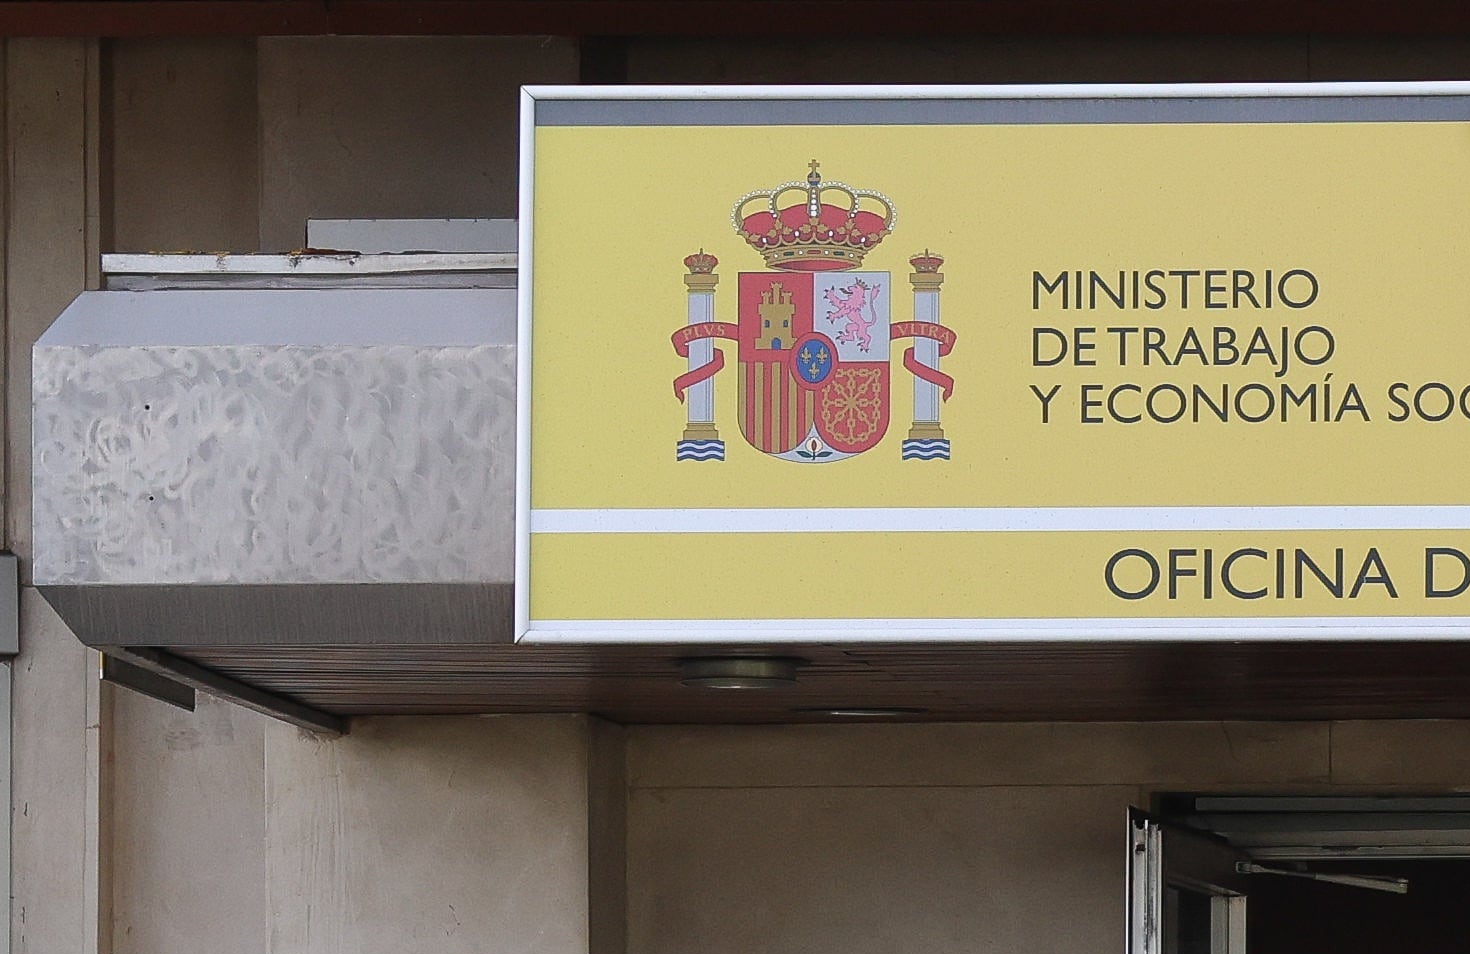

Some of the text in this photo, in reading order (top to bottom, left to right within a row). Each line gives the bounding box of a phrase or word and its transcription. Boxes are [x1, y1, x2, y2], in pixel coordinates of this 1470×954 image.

[1032, 269, 1319, 310] MINISTERIO
[1032, 325, 1335, 379] DE TRABAJO
[1029, 384, 1054, 424] Y
[1080, 372, 1371, 424] ECONOMÍA
[1104, 547, 1399, 600] OFICINA
